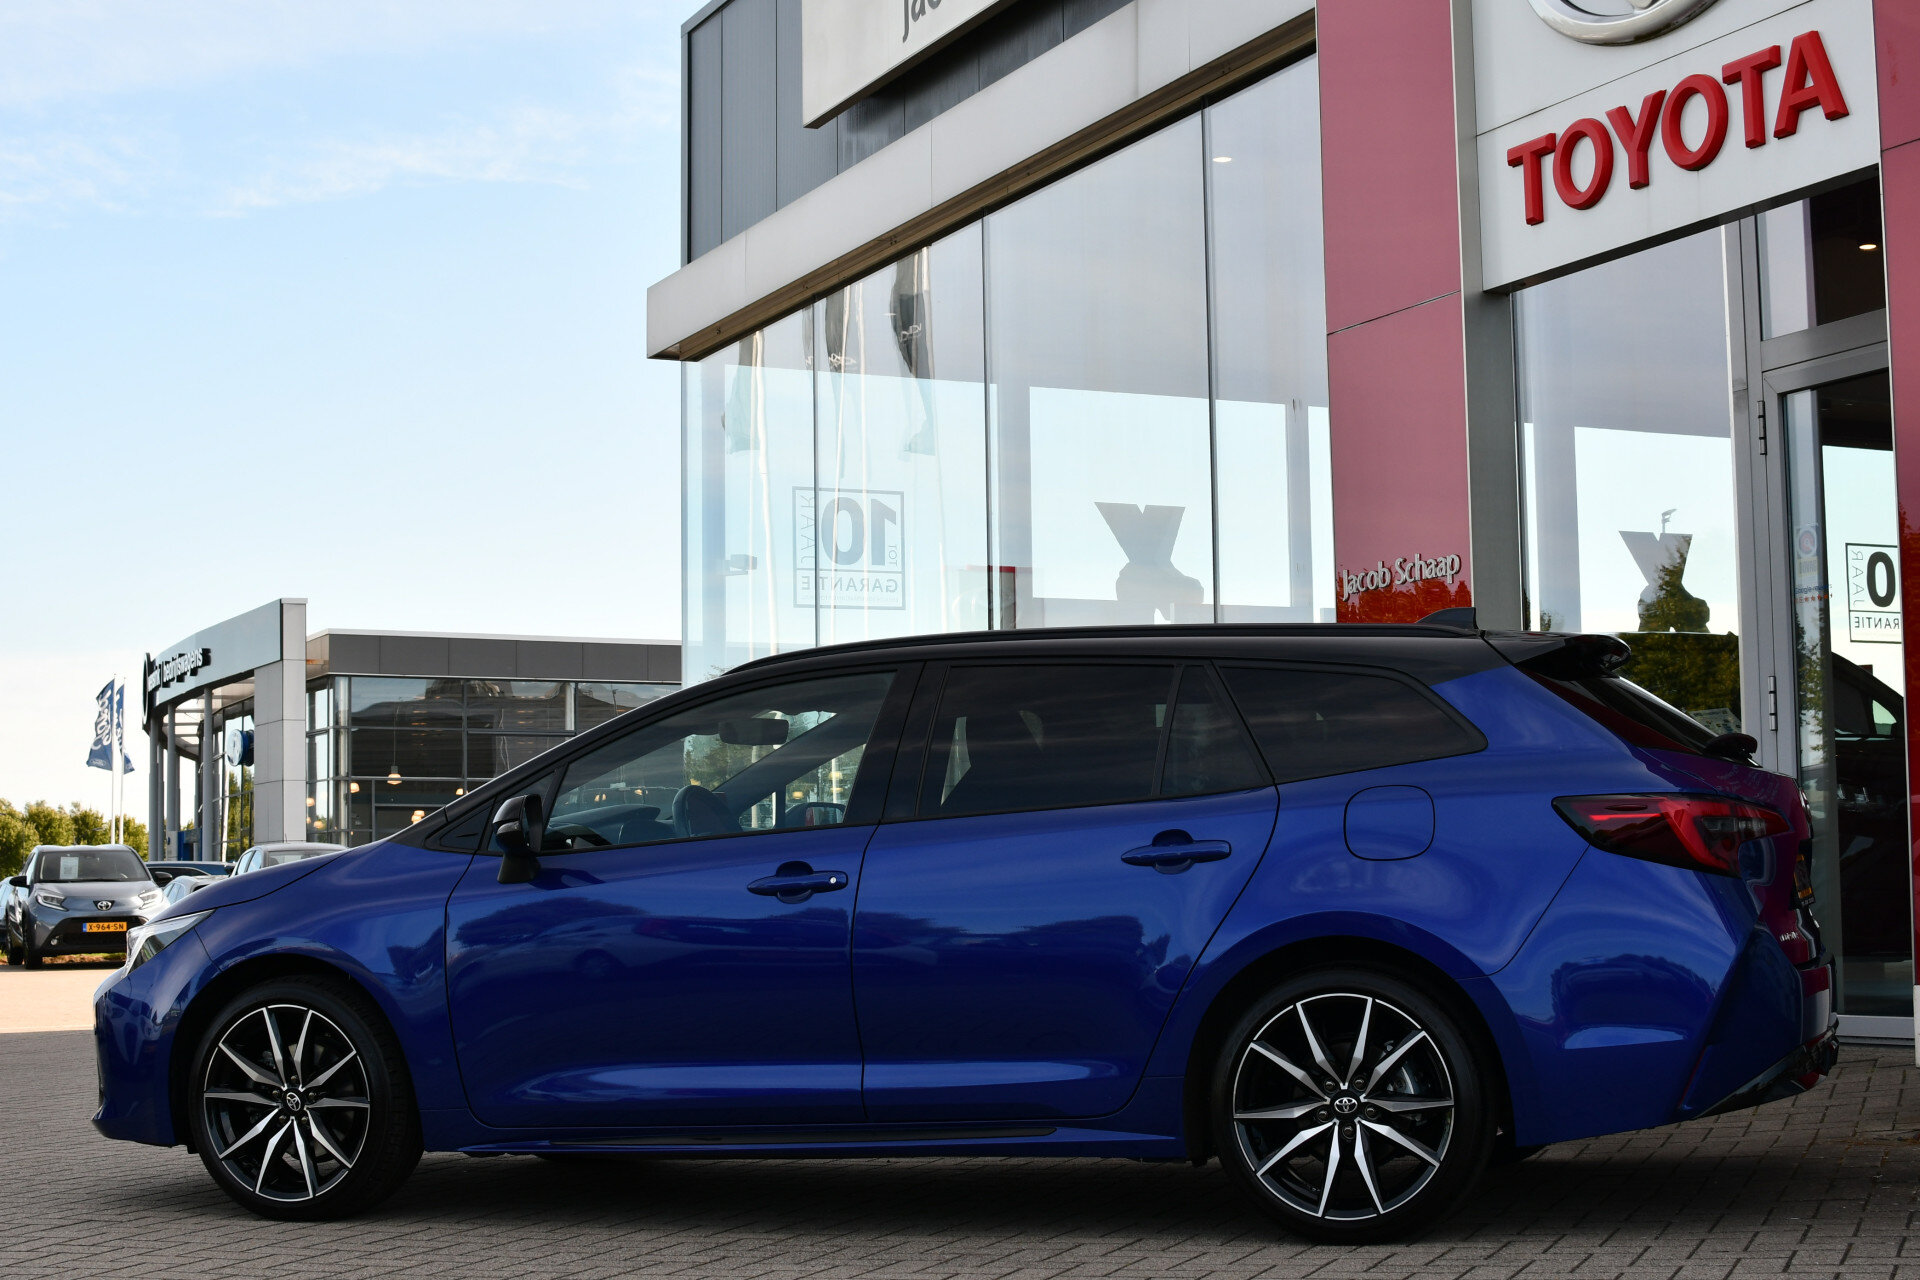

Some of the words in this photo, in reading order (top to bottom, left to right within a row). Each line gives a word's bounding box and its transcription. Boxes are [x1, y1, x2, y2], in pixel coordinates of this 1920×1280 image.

[902, 0, 942, 43] Ja
[1507, 30, 1849, 226] TOYOTA
[1342, 561, 1392, 602] Jacob
[1394, 553, 1461, 585] Schaap
[88, 923, 124, 931] X-964-SN
